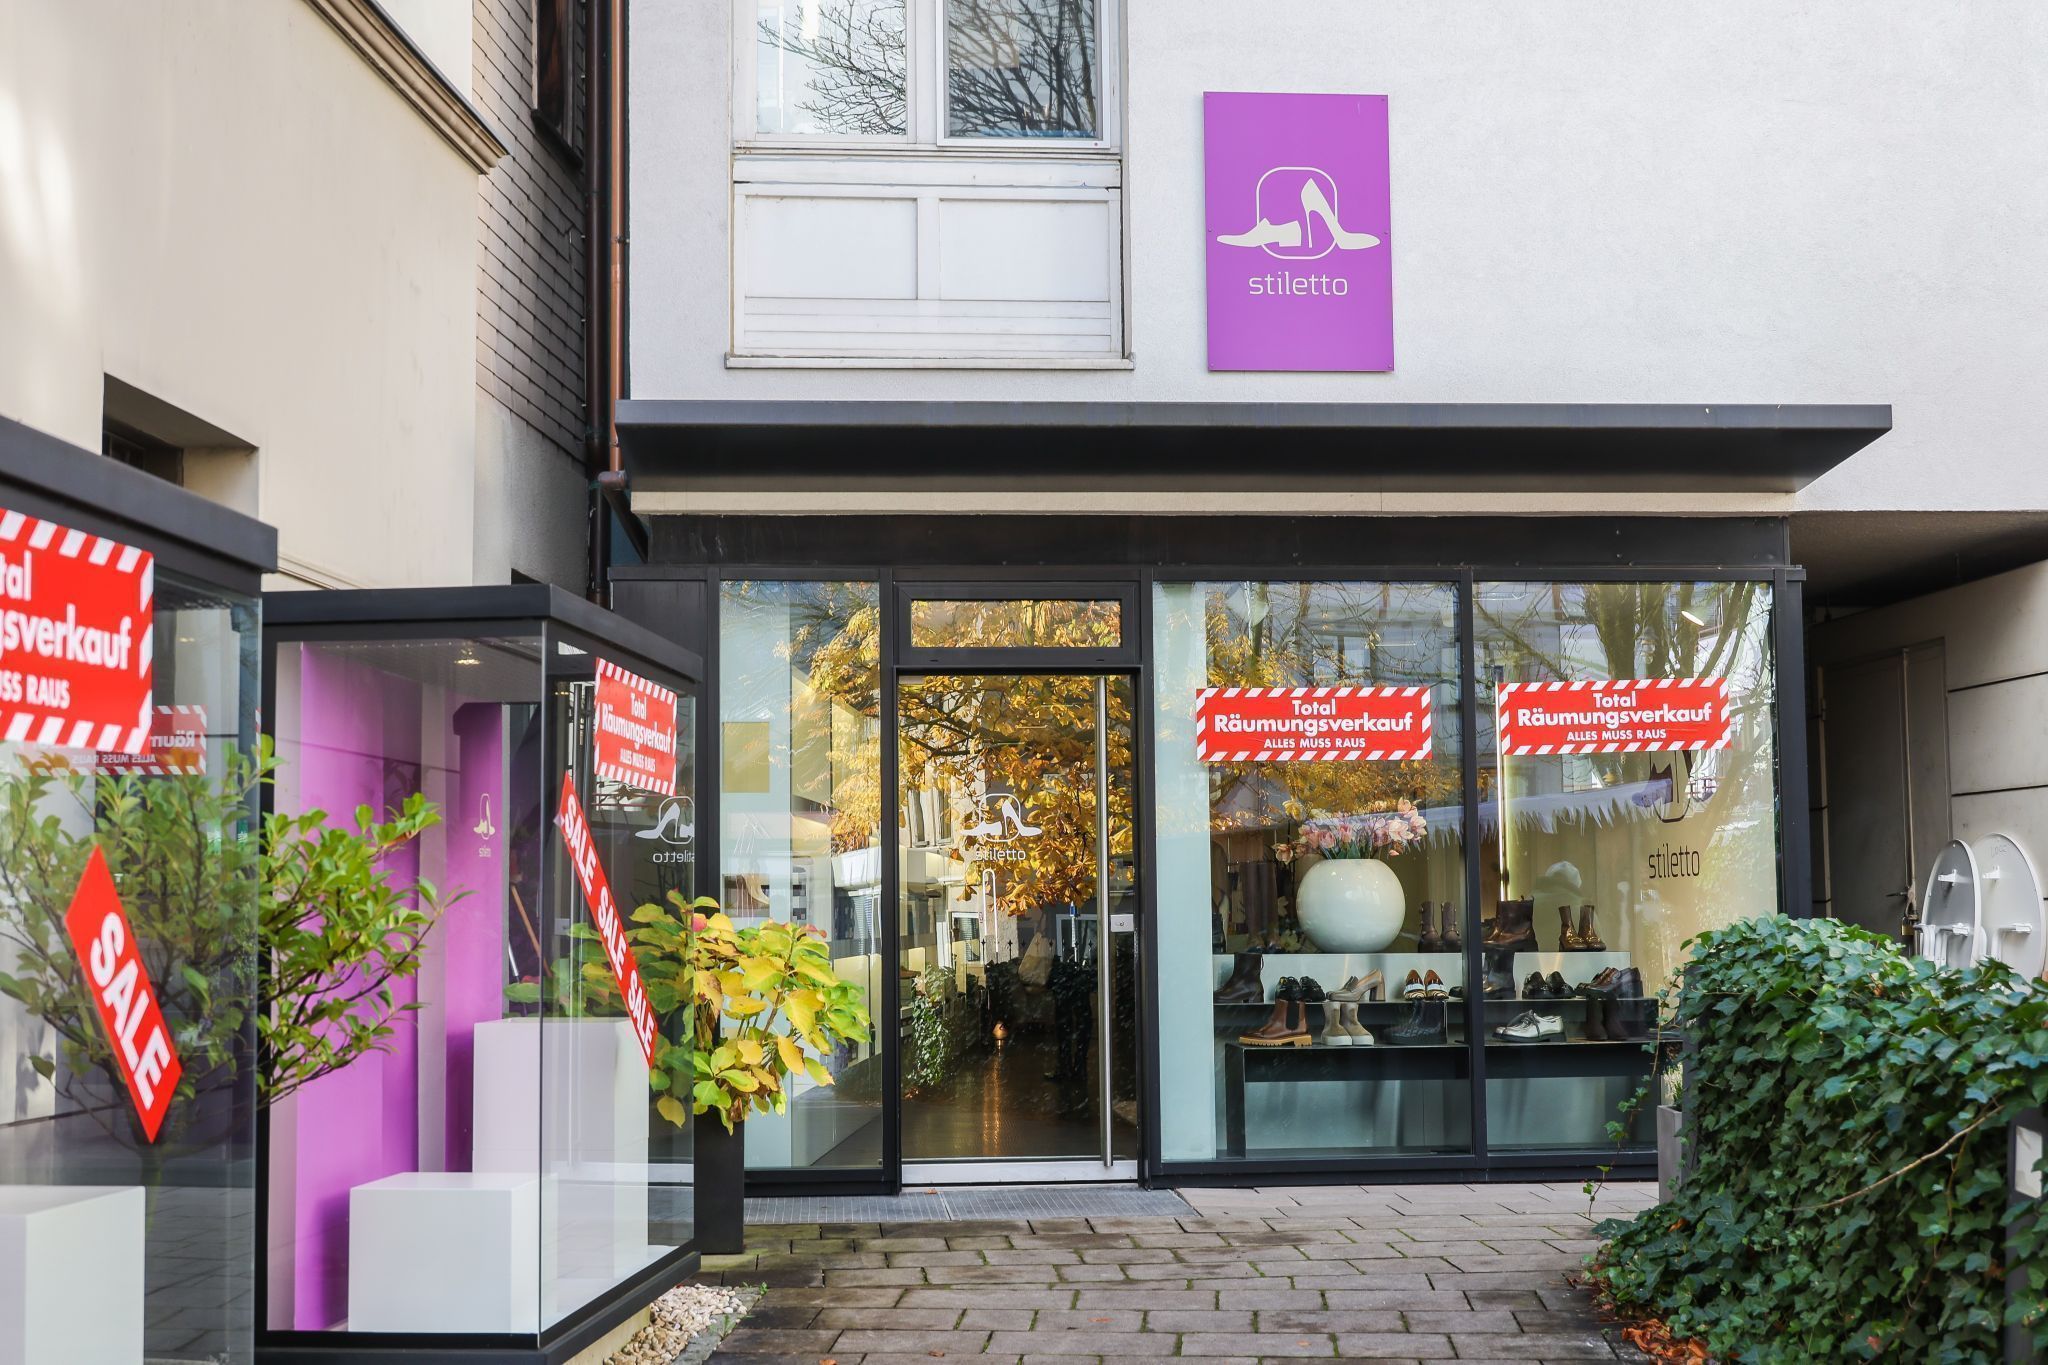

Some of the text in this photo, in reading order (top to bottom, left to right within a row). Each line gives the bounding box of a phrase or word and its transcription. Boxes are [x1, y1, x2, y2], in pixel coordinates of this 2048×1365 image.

[1249, 271, 1348, 296] stiletto
[0, 602, 132, 671] sverkauf
[26, 673, 70, 710] RAUS
[1592, 691, 1637, 709] Total
[630, 692, 647, 720] Total
[1292, 698, 1336, 716] Total
[1517, 702, 1713, 729] Räumungsverkauf
[602, 702, 672, 754] Räumungsverkauf
[1214, 712, 1413, 736] Räumungsverkauf
[1567, 728, 1667, 742] ALLES MUSS RAUS
[1264, 737, 1366, 749] ALLES MUSS RAUS
[976, 847, 1026, 861] stiletto
[1648, 843, 1700, 879] stiletto
[564, 794, 655, 1058] SALE SALE SALE
[90, 911, 171, 1111] SALE
